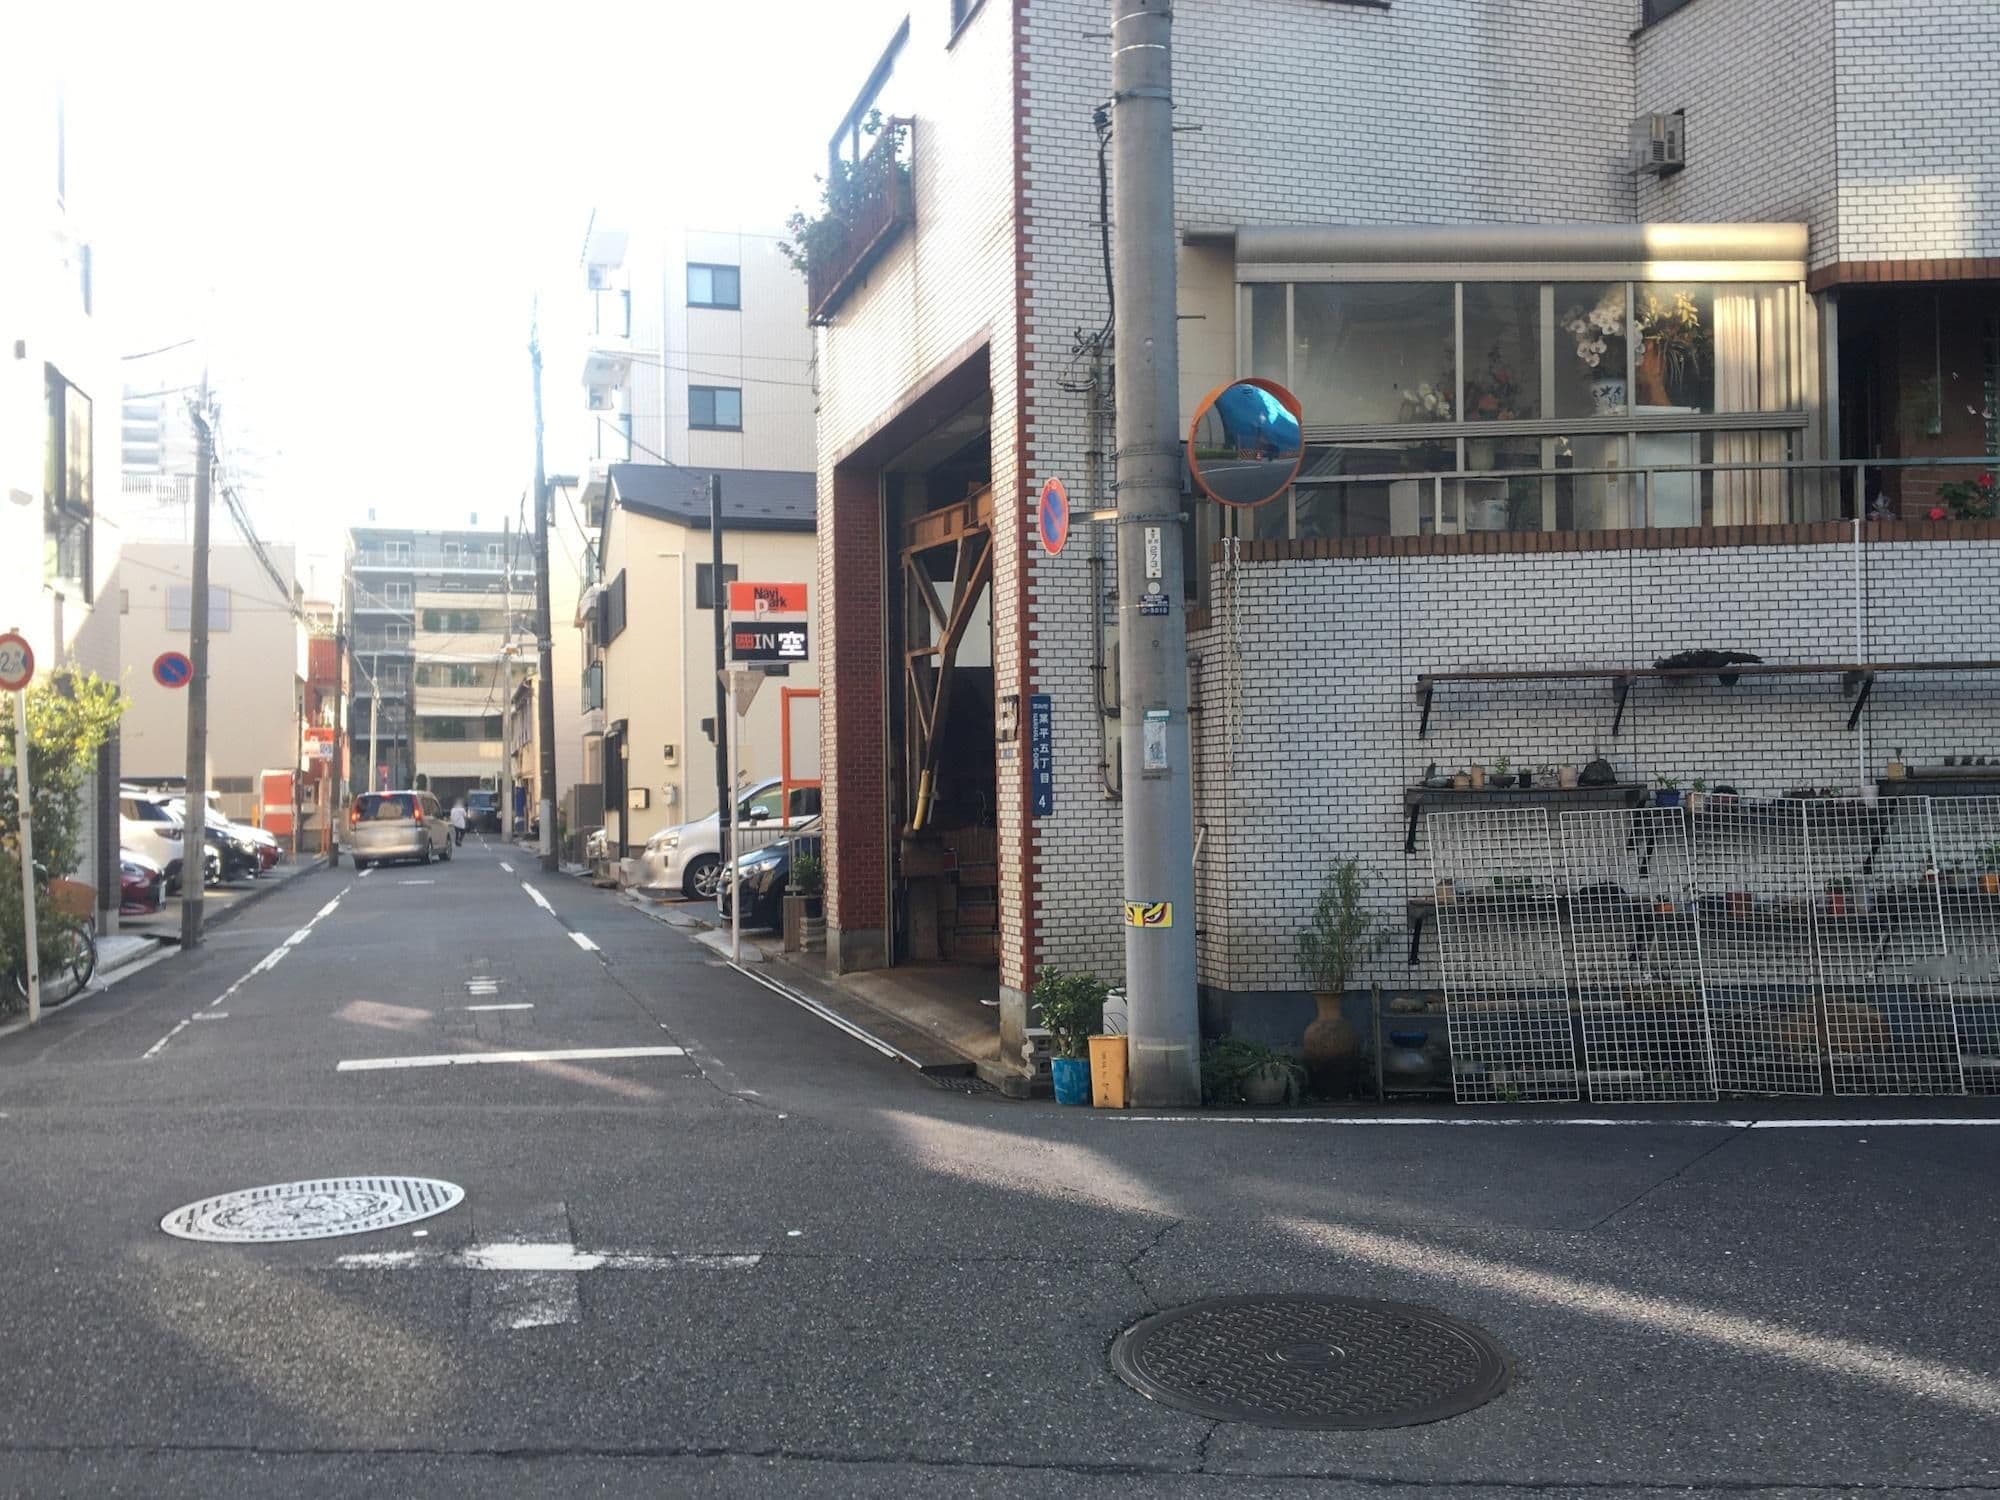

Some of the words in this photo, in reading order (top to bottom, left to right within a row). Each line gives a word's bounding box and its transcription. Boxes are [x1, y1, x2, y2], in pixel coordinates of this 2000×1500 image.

[754, 587, 779, 599] Navi
[754, 597, 787, 620] Park
[754, 633, 775, 649] IN
[778, 631, 805, 656] 空
[1038, 794, 1046, 808] 4
